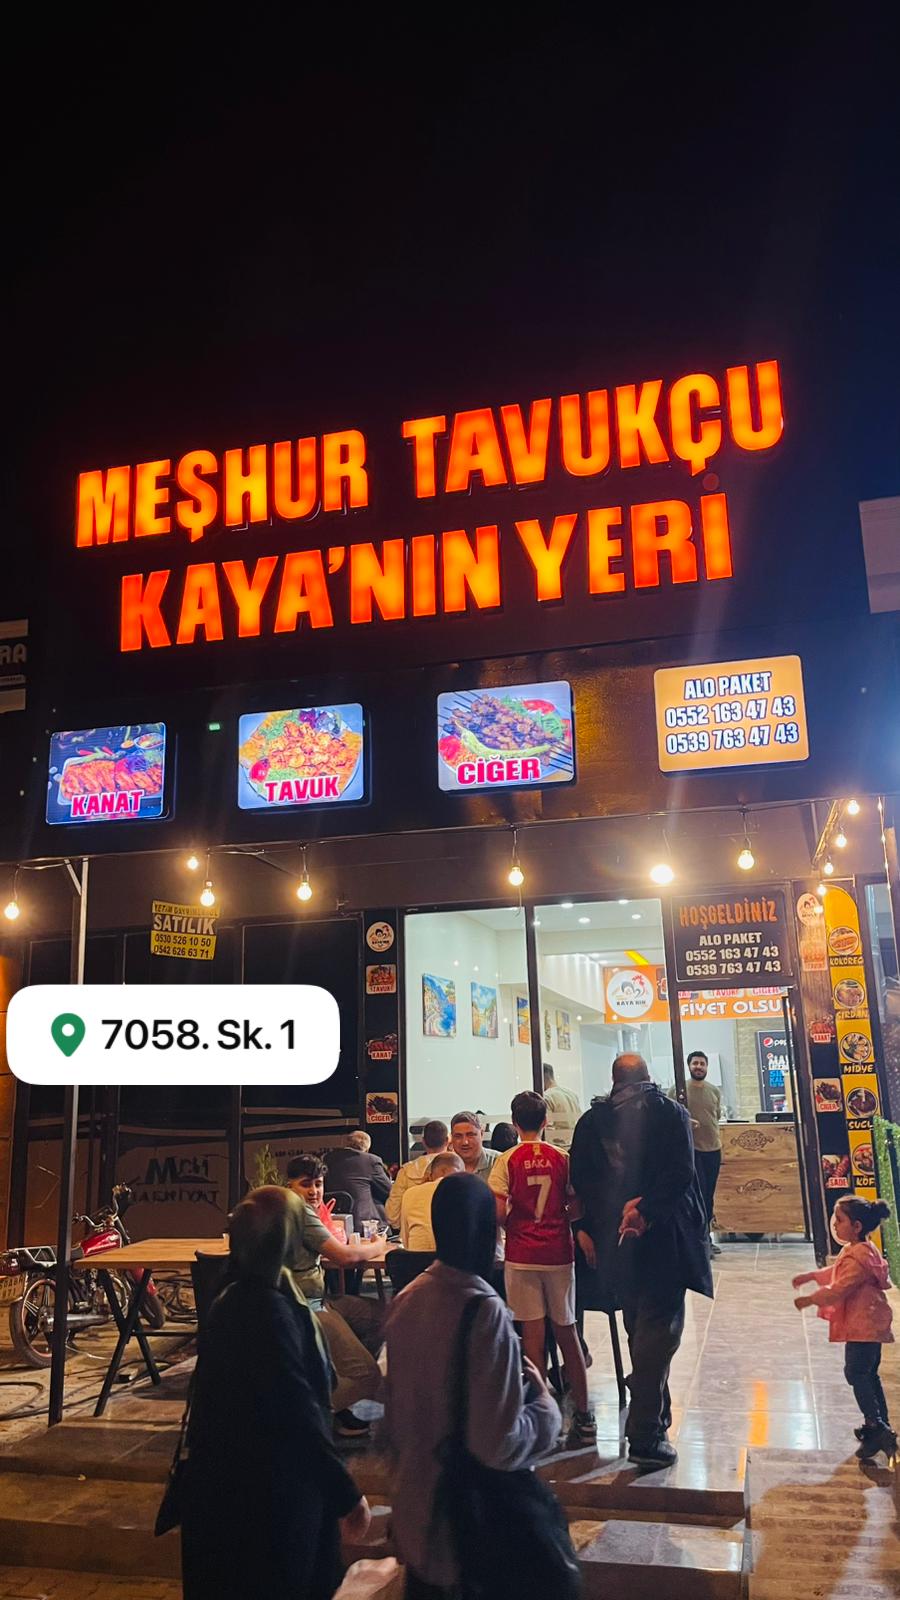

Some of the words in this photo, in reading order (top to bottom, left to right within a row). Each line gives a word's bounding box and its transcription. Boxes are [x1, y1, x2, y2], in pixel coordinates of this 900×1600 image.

[76, 430, 368, 542] MEŞHUR
[403, 360, 784, 477] TAVUKÇU
[120, 526, 502, 652] KAYA'NIN
[515, 475, 733, 602] YERİ
[684, 676, 715, 699] ALO
[719, 672, 772, 697] PAKET
[665, 704, 710, 728] 0552
[712, 701, 742, 722] 163
[744, 699, 767, 719] 47
[772, 696, 796, 717] 43
[666, 731, 710, 754] 0539
[713, 728, 745, 749] 763
[748, 726, 770, 746] 47
[774, 722, 799, 744] 43
[456, 755, 542, 785] CİĞER
[264, 776, 340, 803] TAVUK
[71, 790, 144, 816] KANAT
[153, 914, 216, 935] SATILIK
[679, 896, 778, 930] HOŞGELDİNİZ
[154, 934, 171, 943] 0530
[173, 935, 187, 945] 526
[189, 937, 199, 946] 10
[201, 938, 211, 947] 50
[154, 945, 171, 953] 0542
[173, 946, 185, 955] 626
[200, 949, 209, 958] 71
[699, 934, 722, 946] ALO
[724, 932, 762, 945] PAKET
[686, 949, 717, 962] 0552
[719, 948, 742, 961] 163
[744, 947, 761, 959] 47
[763, 945, 779, 958] 43
[686, 963, 717, 976] 0539
[719, 962, 743, 975] 763
[745, 961, 762, 973] 47
[764, 960, 782, 972] 43
[733, 997, 783, 1014] OLSU
[843, 1063, 874, 1074] MİDYE
[829, 1178, 847, 1186] SADE
[526, 1174, 552, 1224] 7
